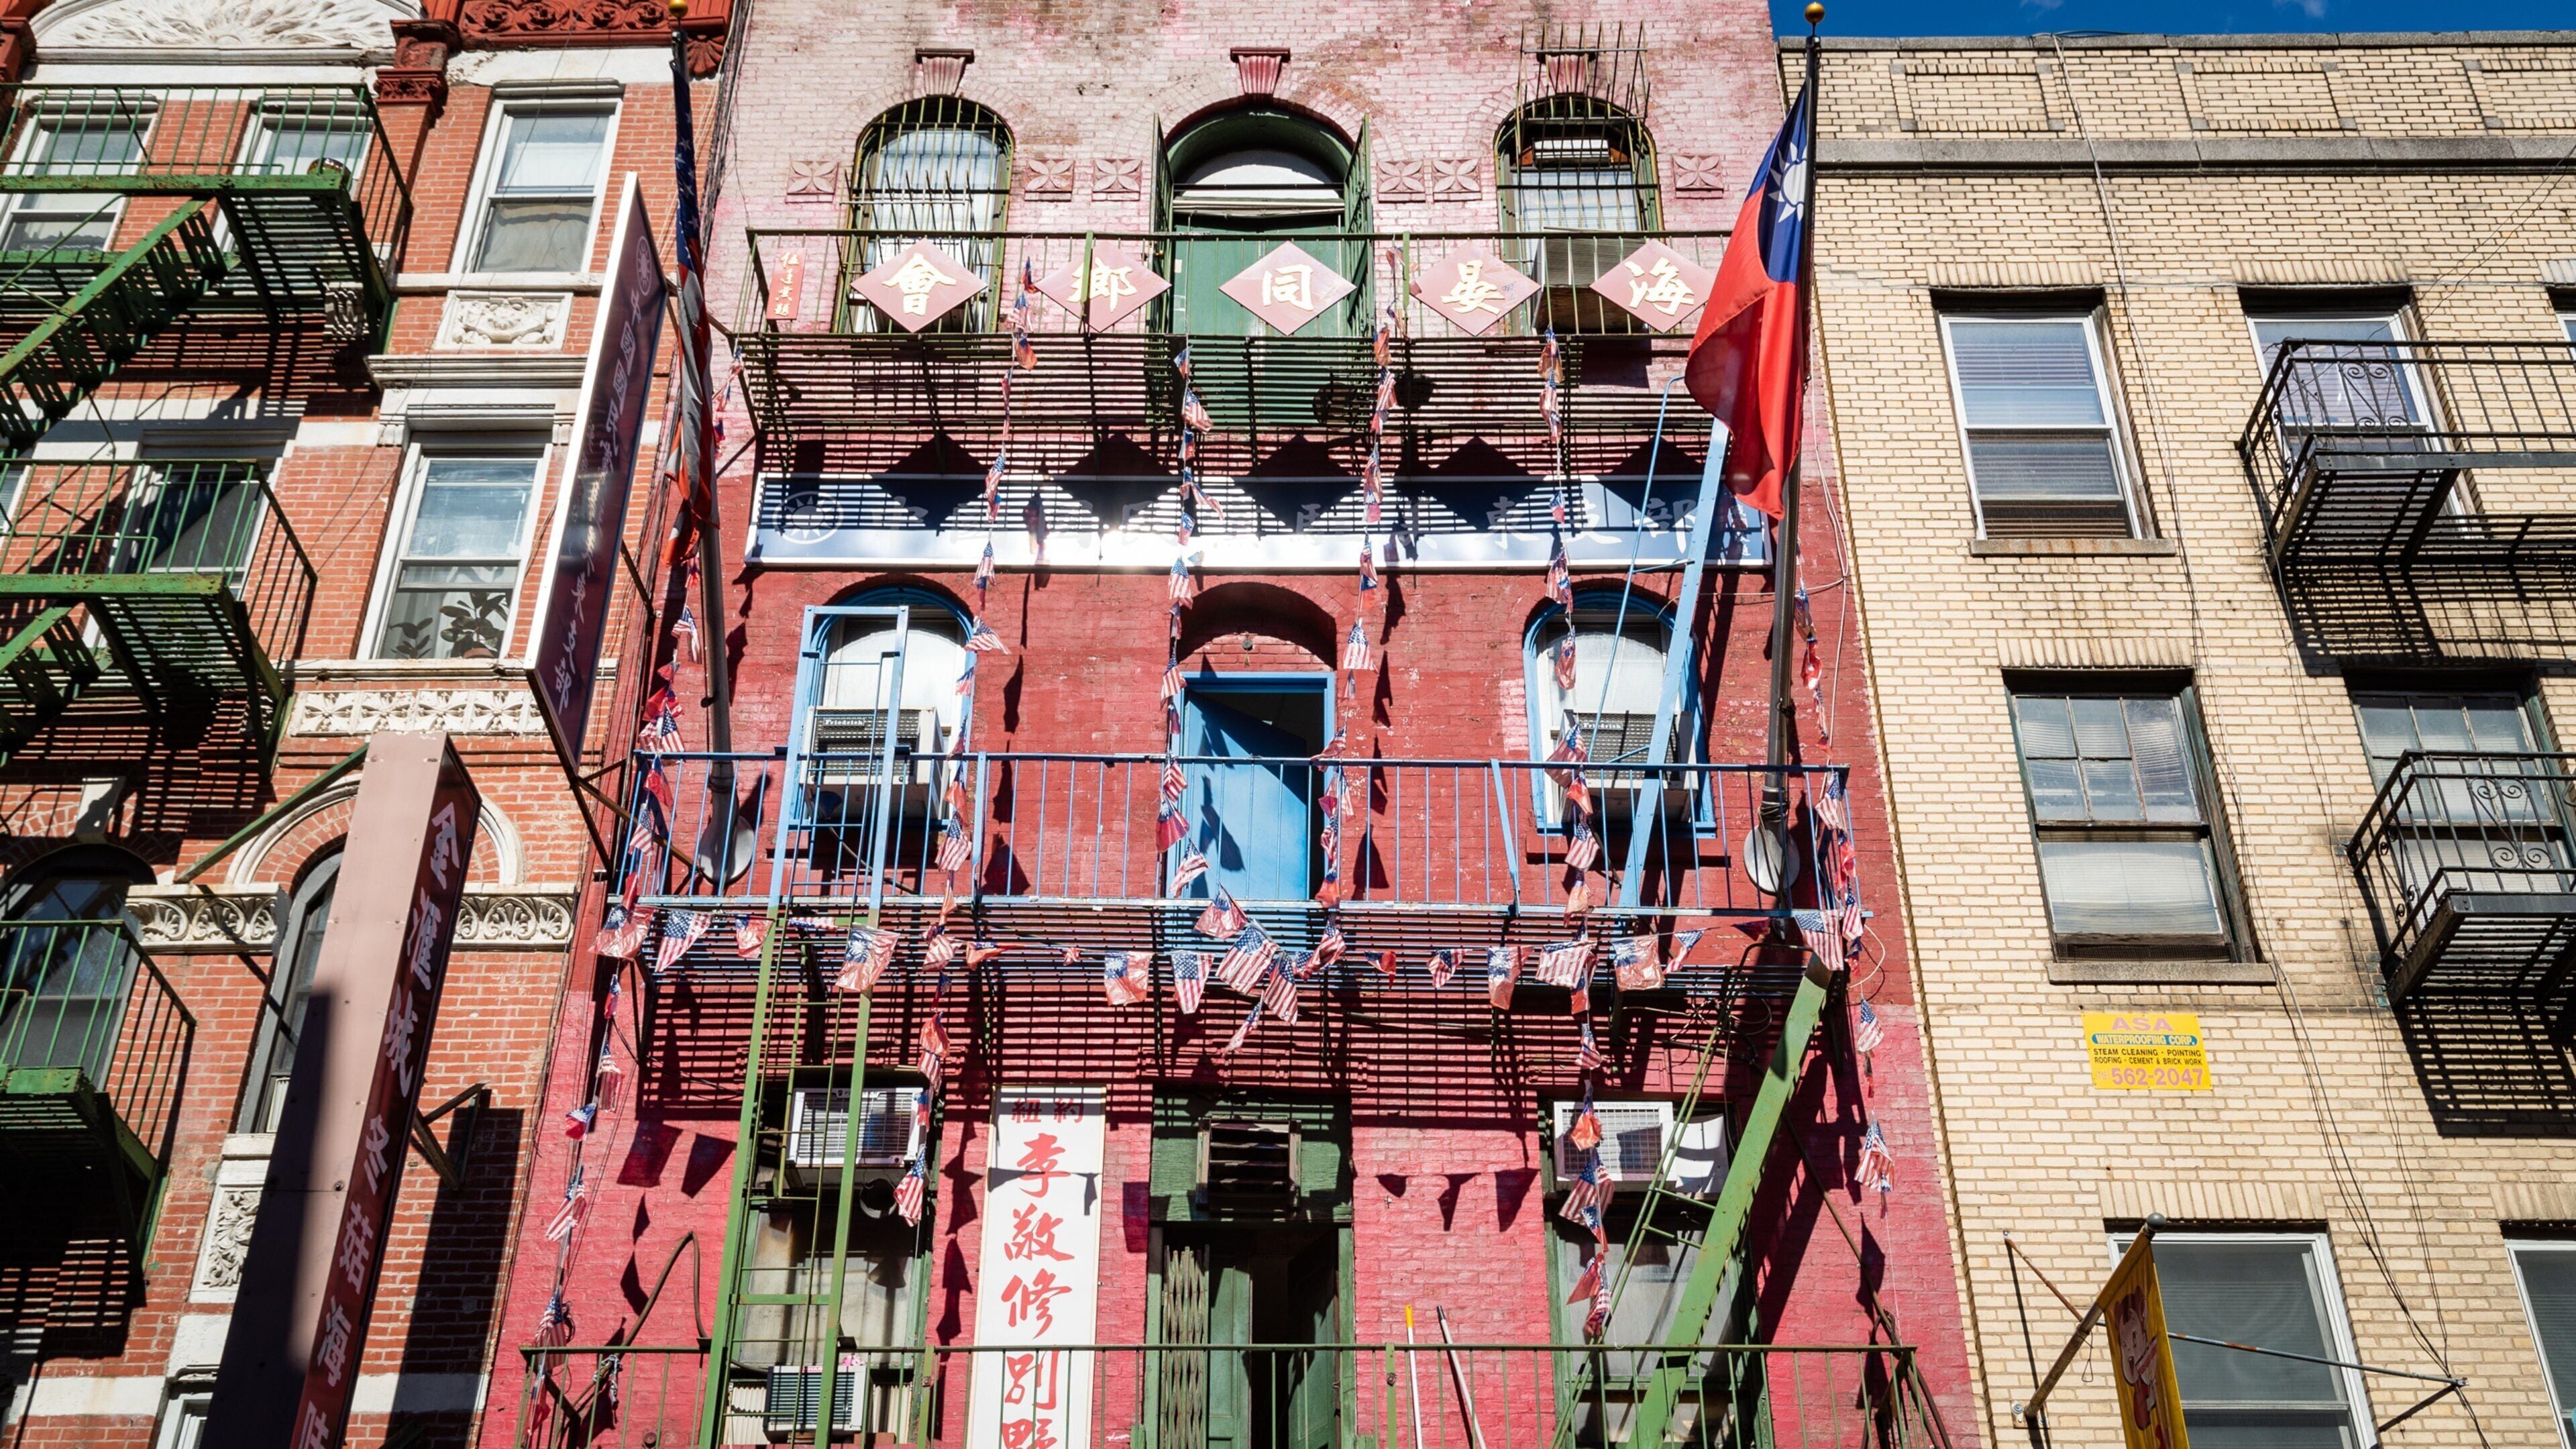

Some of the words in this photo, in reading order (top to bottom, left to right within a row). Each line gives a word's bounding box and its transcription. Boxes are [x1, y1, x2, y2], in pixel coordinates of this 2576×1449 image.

[2112, 1017, 2174, 1032] ASA
[2096, 1034, 2167, 1045] WATERPROOFING
[2169, 1034, 2196, 1046] CORP.
[2111, 1067, 2203, 1086] 562-2047
